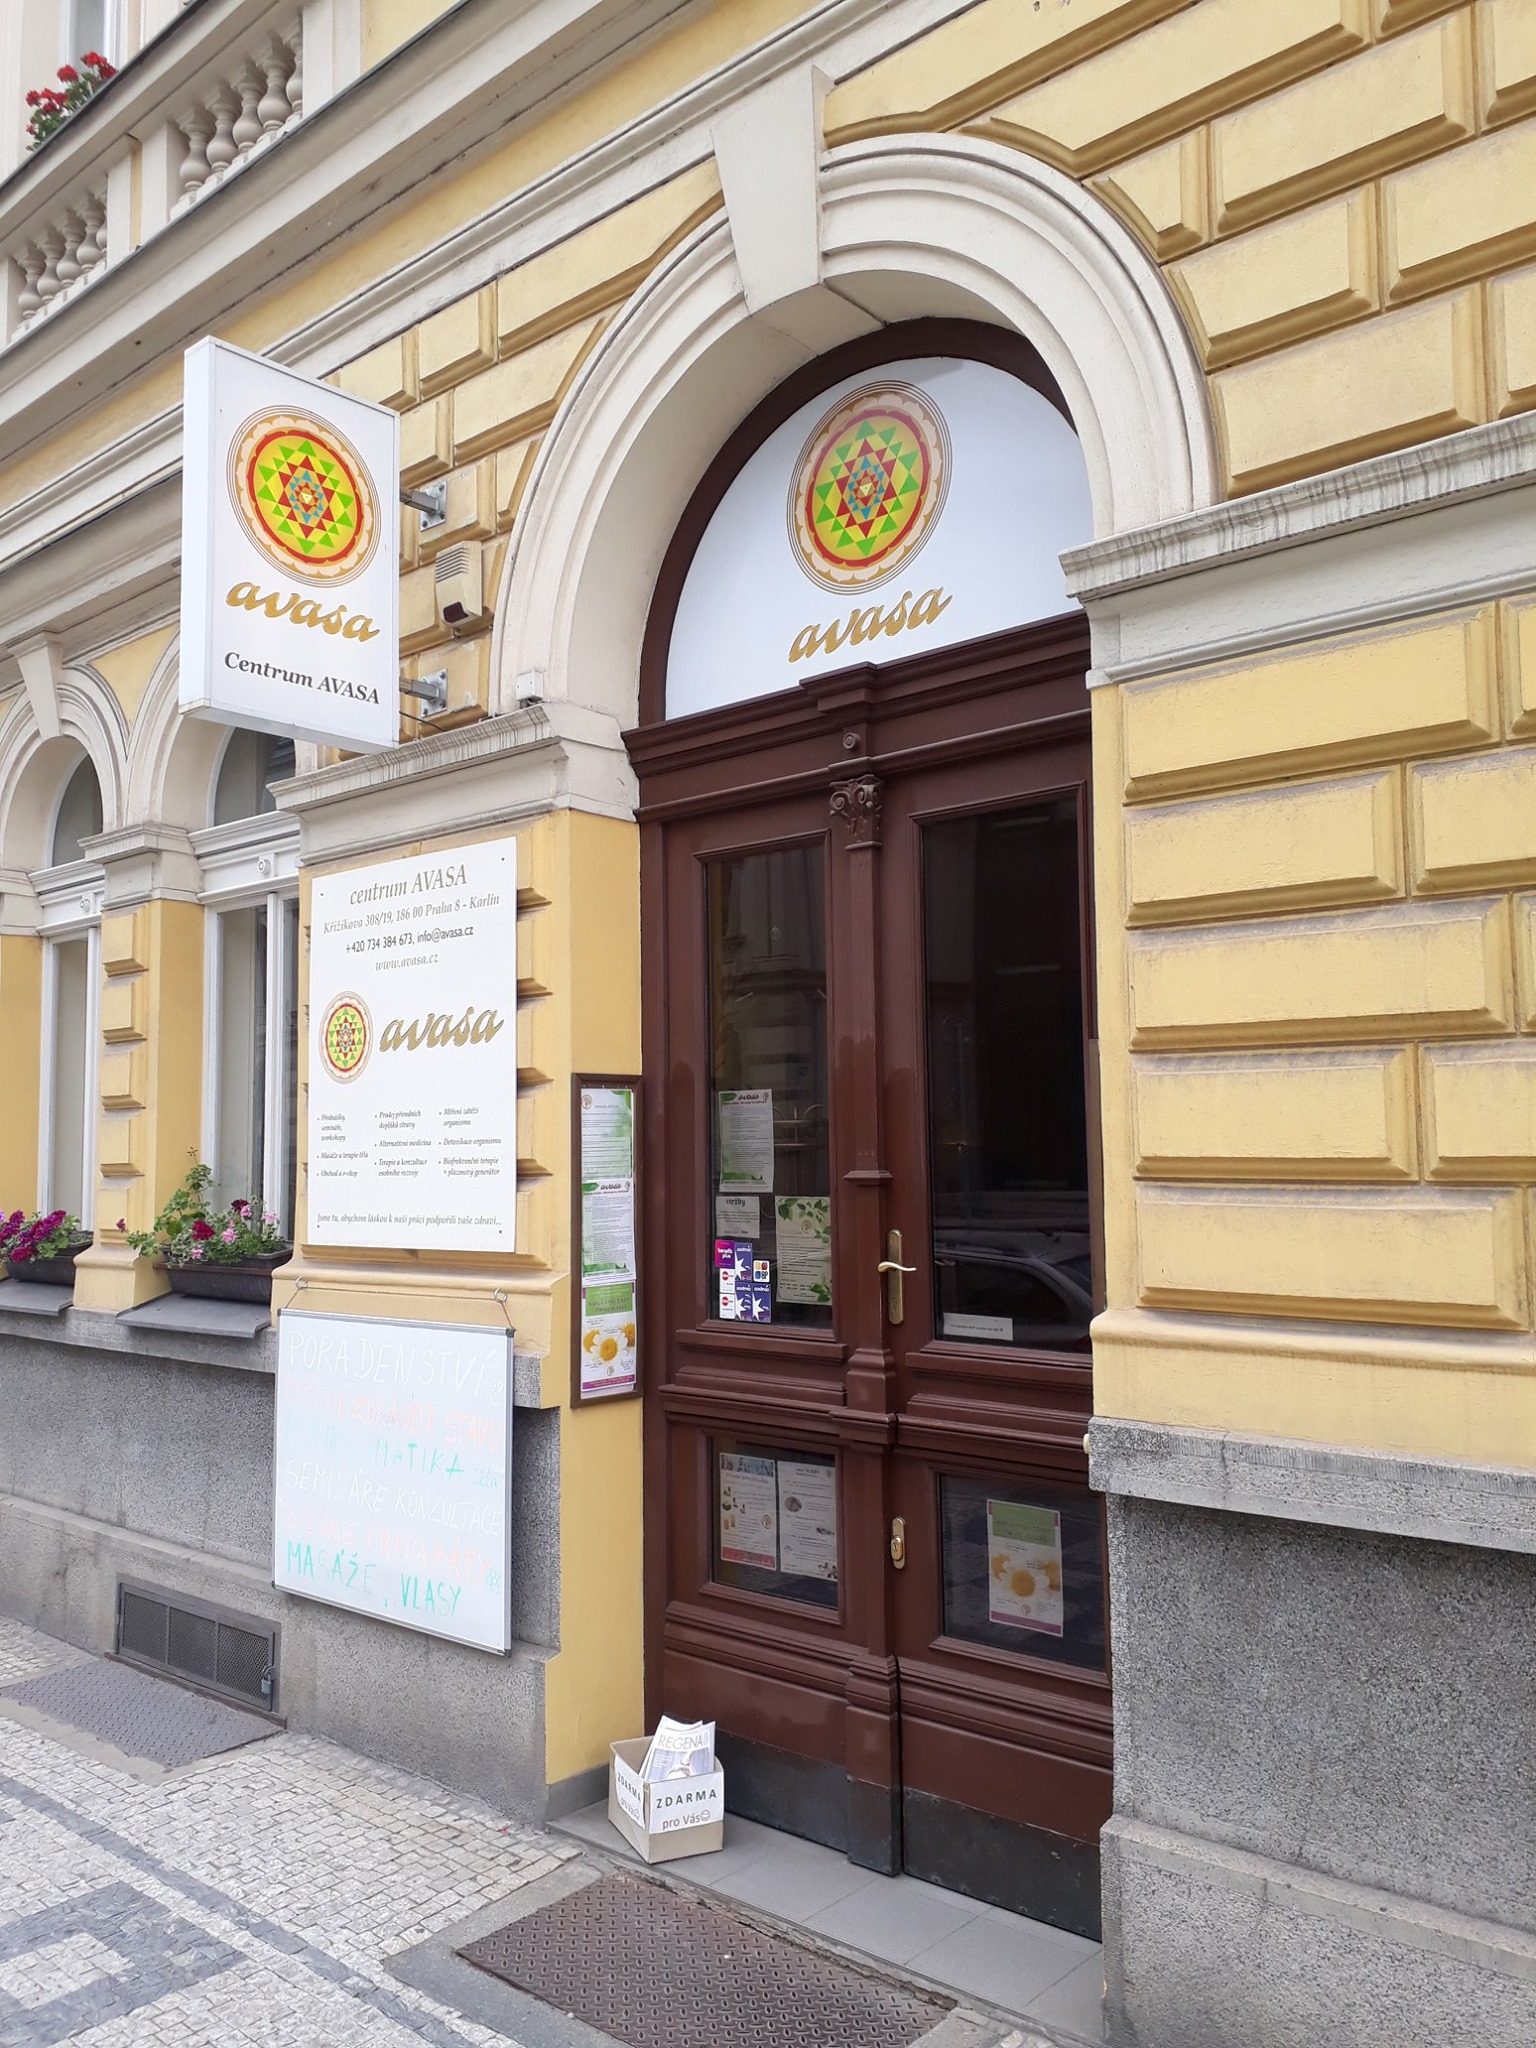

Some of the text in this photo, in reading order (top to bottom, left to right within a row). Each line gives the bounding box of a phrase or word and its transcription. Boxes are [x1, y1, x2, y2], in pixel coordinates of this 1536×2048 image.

[224, 581, 381, 643] avasa
[787, 586, 953, 663] avasa
[224, 651, 381, 705] Centrum AVASA
[349, 864, 467, 905] centrum AVASA
[323, 913, 363, 934] Křižíkova
[364, 910, 395, 929] 308/19,
[396, 908, 411, 921] 186
[412, 906, 424, 919] 00
[425, 901, 453, 917] Praha
[454, 899, 461, 912] 8
[469, 892, 500, 910] Karlín
[344, 925, 474, 954] +420 734 384 673, info@avasa.cz
[375, 952, 439, 971] www.avasa.cz
[378, 1006, 505, 1053] avasa
[378, 1158, 396, 1168] Terapie
[480, 1156, 499, 1166] terapie
[317, 1214, 331, 1225] Jsme
[368, 1213, 388, 1225] láskou
[407, 1215, 425, 1227] práci
[457, 1216, 473, 1226] vaše
[398, 1572, 463, 1618] VLASY
[617, 1771, 641, 1803] ZDARMA
[655, 1788, 717, 1810] ZDARMA
[662, 1813, 701, 1831] pro Vás
